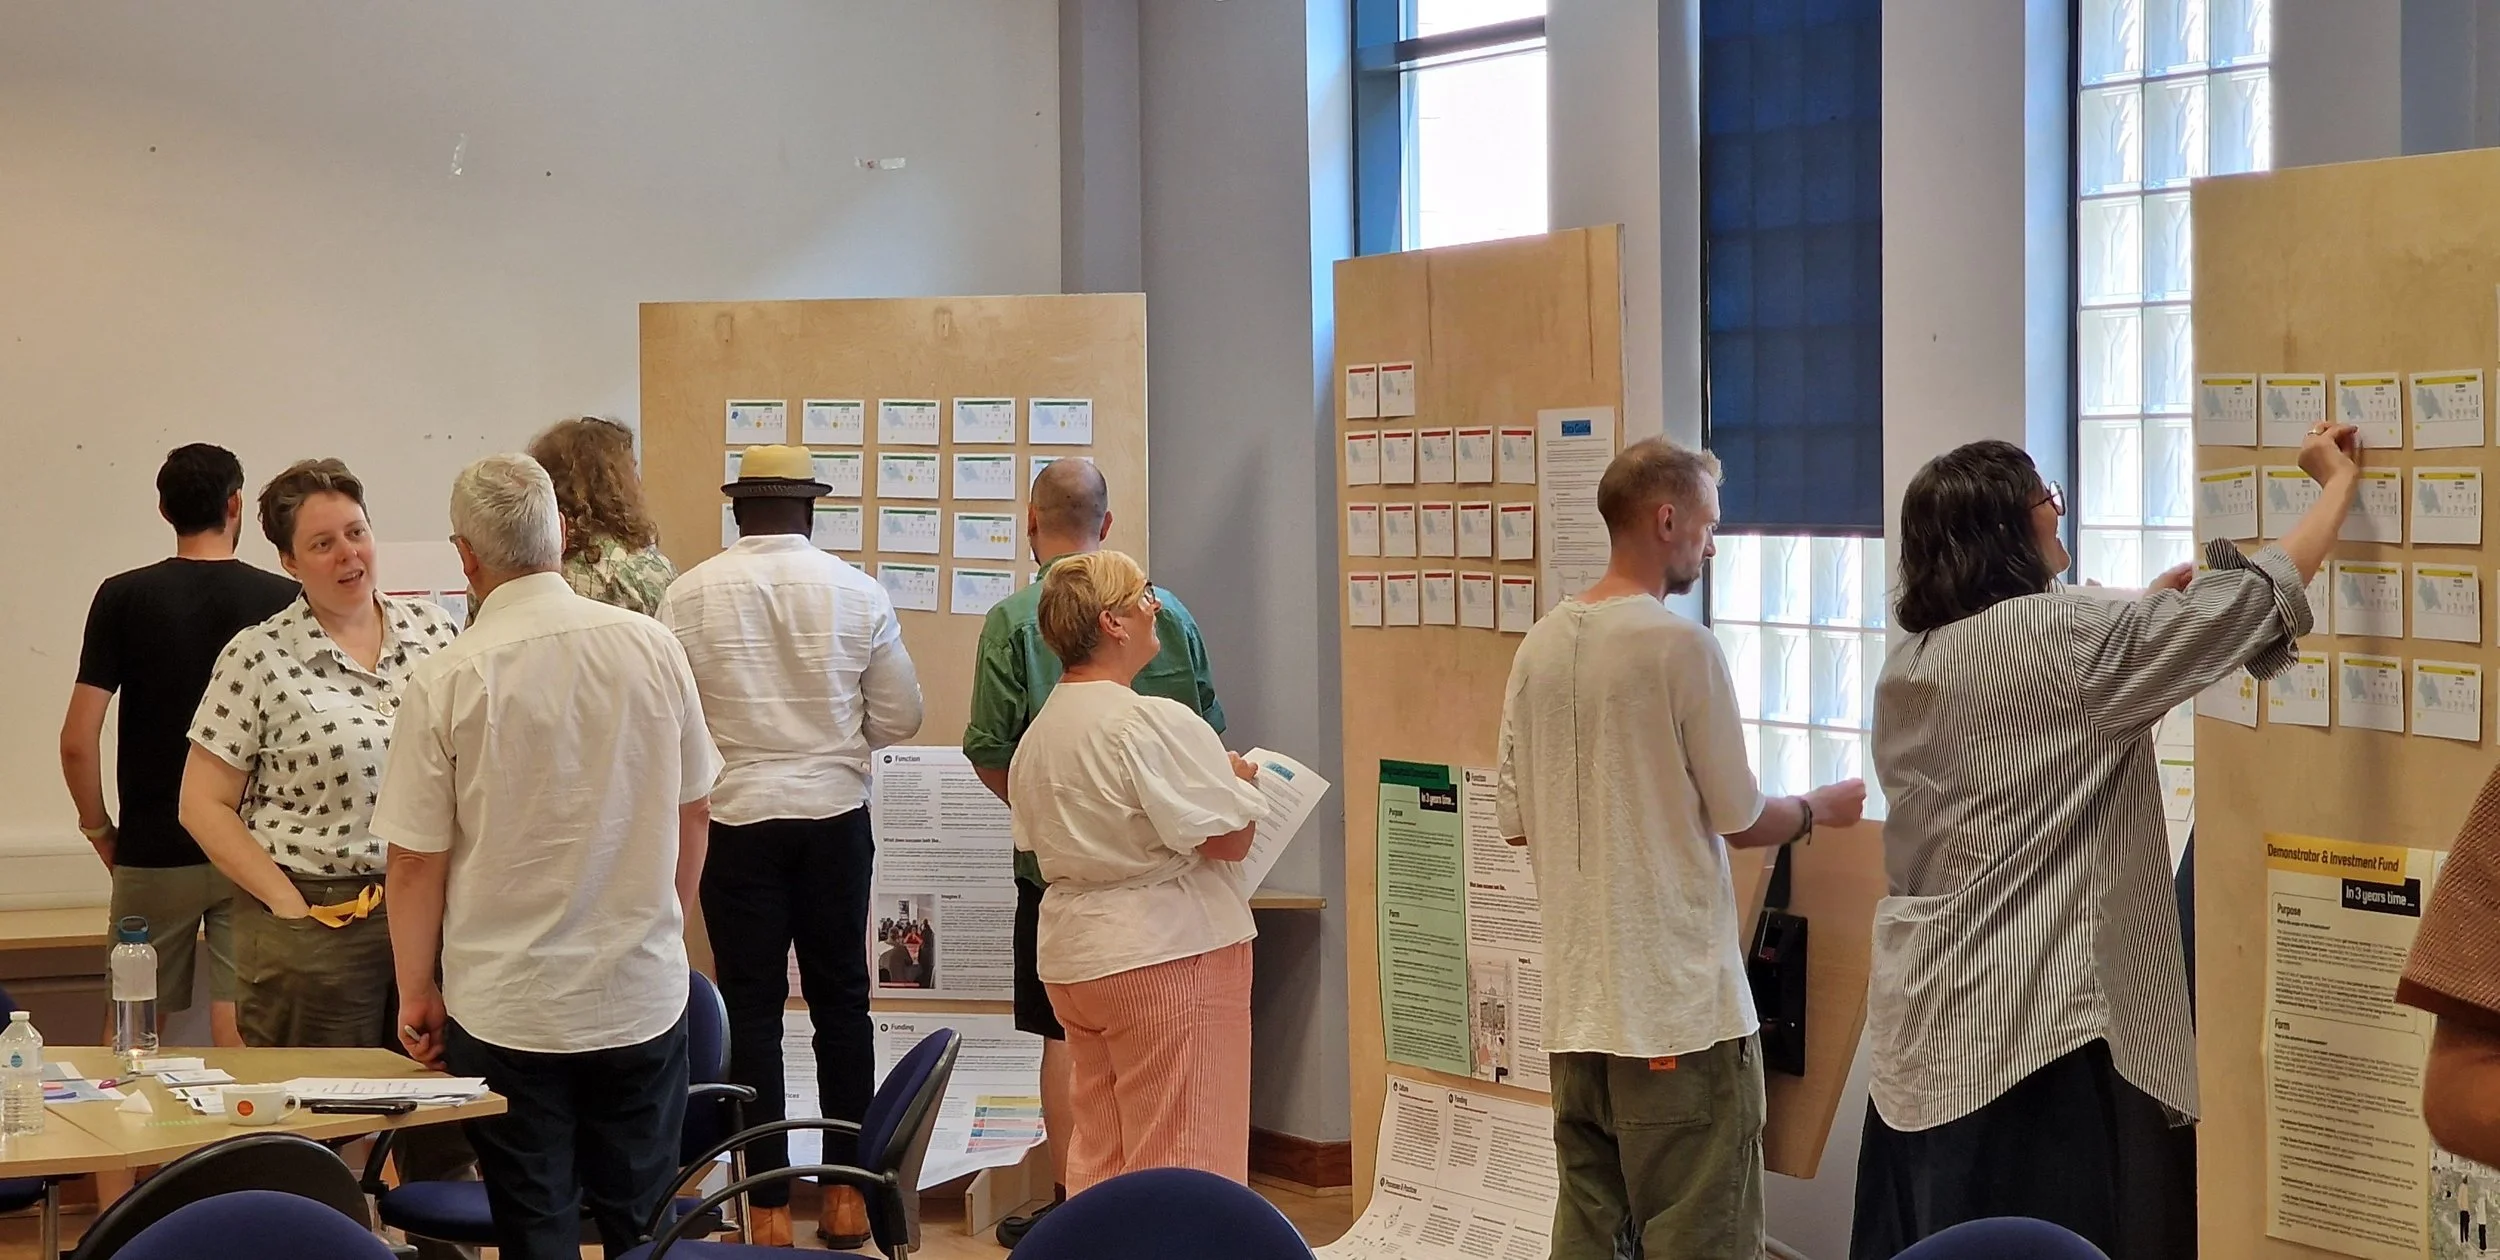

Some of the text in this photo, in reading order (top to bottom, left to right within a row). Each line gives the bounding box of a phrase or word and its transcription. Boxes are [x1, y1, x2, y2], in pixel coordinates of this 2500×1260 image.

[2267, 843, 2399, 872] Demonstrator & Investment Fund
[2346, 885, 2354, 899] In
[2355, 886, 2362, 900] 3
[2362, 891, 2386, 905] years
[2277, 903, 2301, 918] Purpose
[891, 1023, 914, 1032] Funding
[2274, 1018, 2290, 1031] Form
